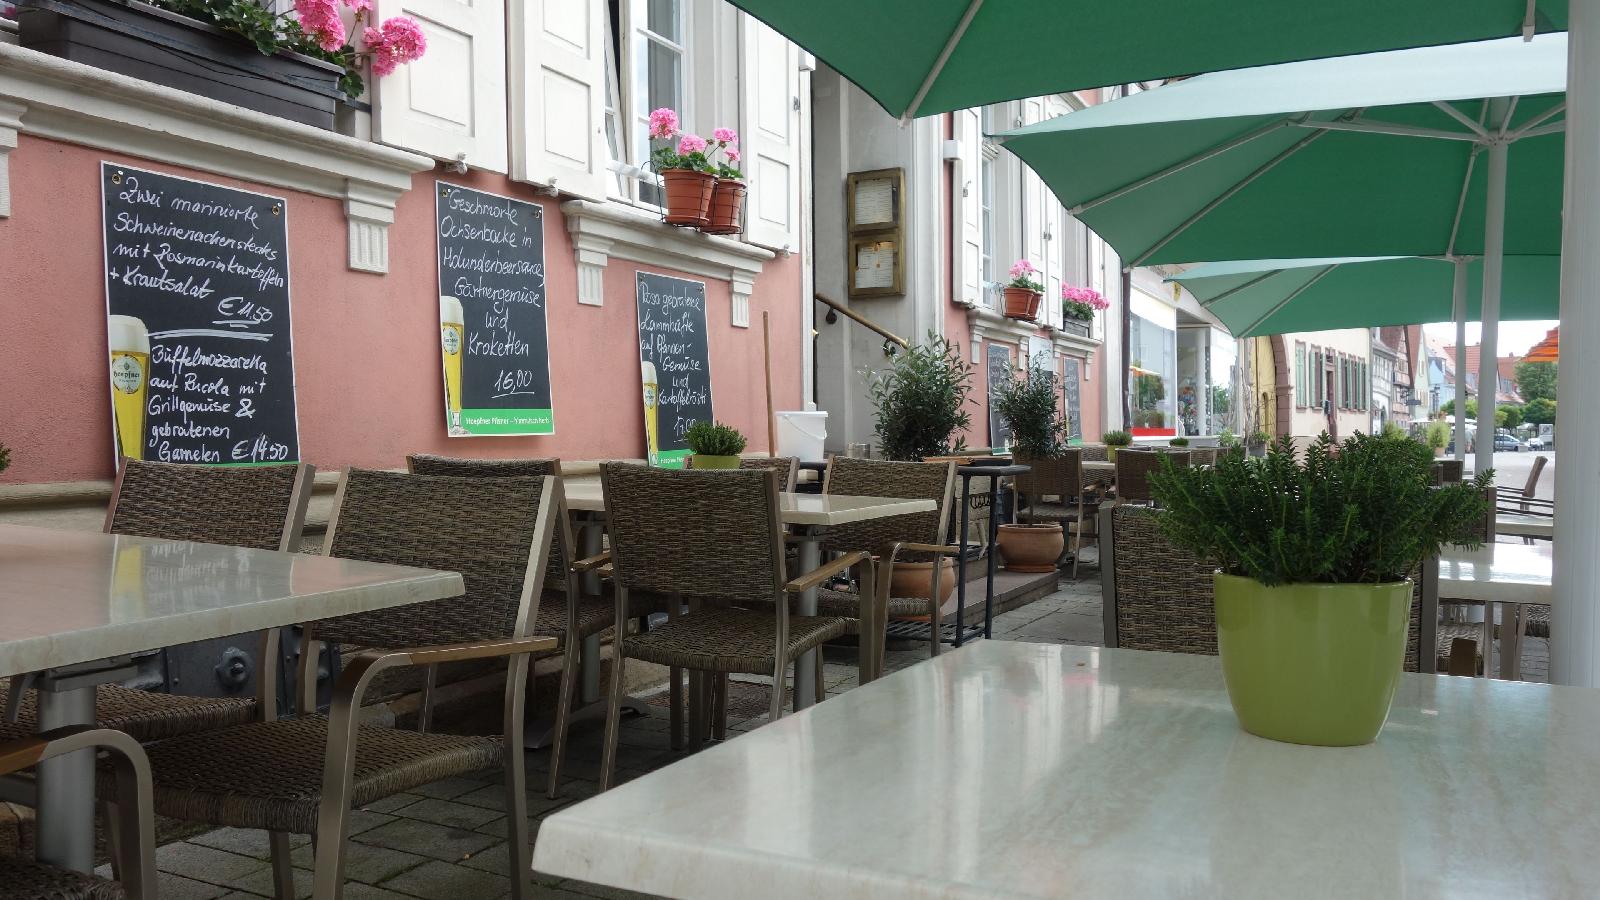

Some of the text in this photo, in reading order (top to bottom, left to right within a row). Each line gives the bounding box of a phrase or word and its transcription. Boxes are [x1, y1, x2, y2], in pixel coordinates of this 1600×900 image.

[119, 176, 164, 207] Zwei
[449, 189, 518, 226] Geschmorte
[113, 212, 278, 260] Schweinenackensteaks
[522, 226, 532, 248] in
[112, 242, 284, 291] mit Rosmarinkartoffeln
[109, 265, 215, 299] + Krautsalat
[485, 307, 509, 332] und
[468, 330, 529, 357] Kroketten
[150, 373, 267, 396] auf Rucola mit
[672, 373, 689, 389] und
[148, 394, 256, 424] Grillgemüse &
[149, 421, 230, 448] gebratenen
